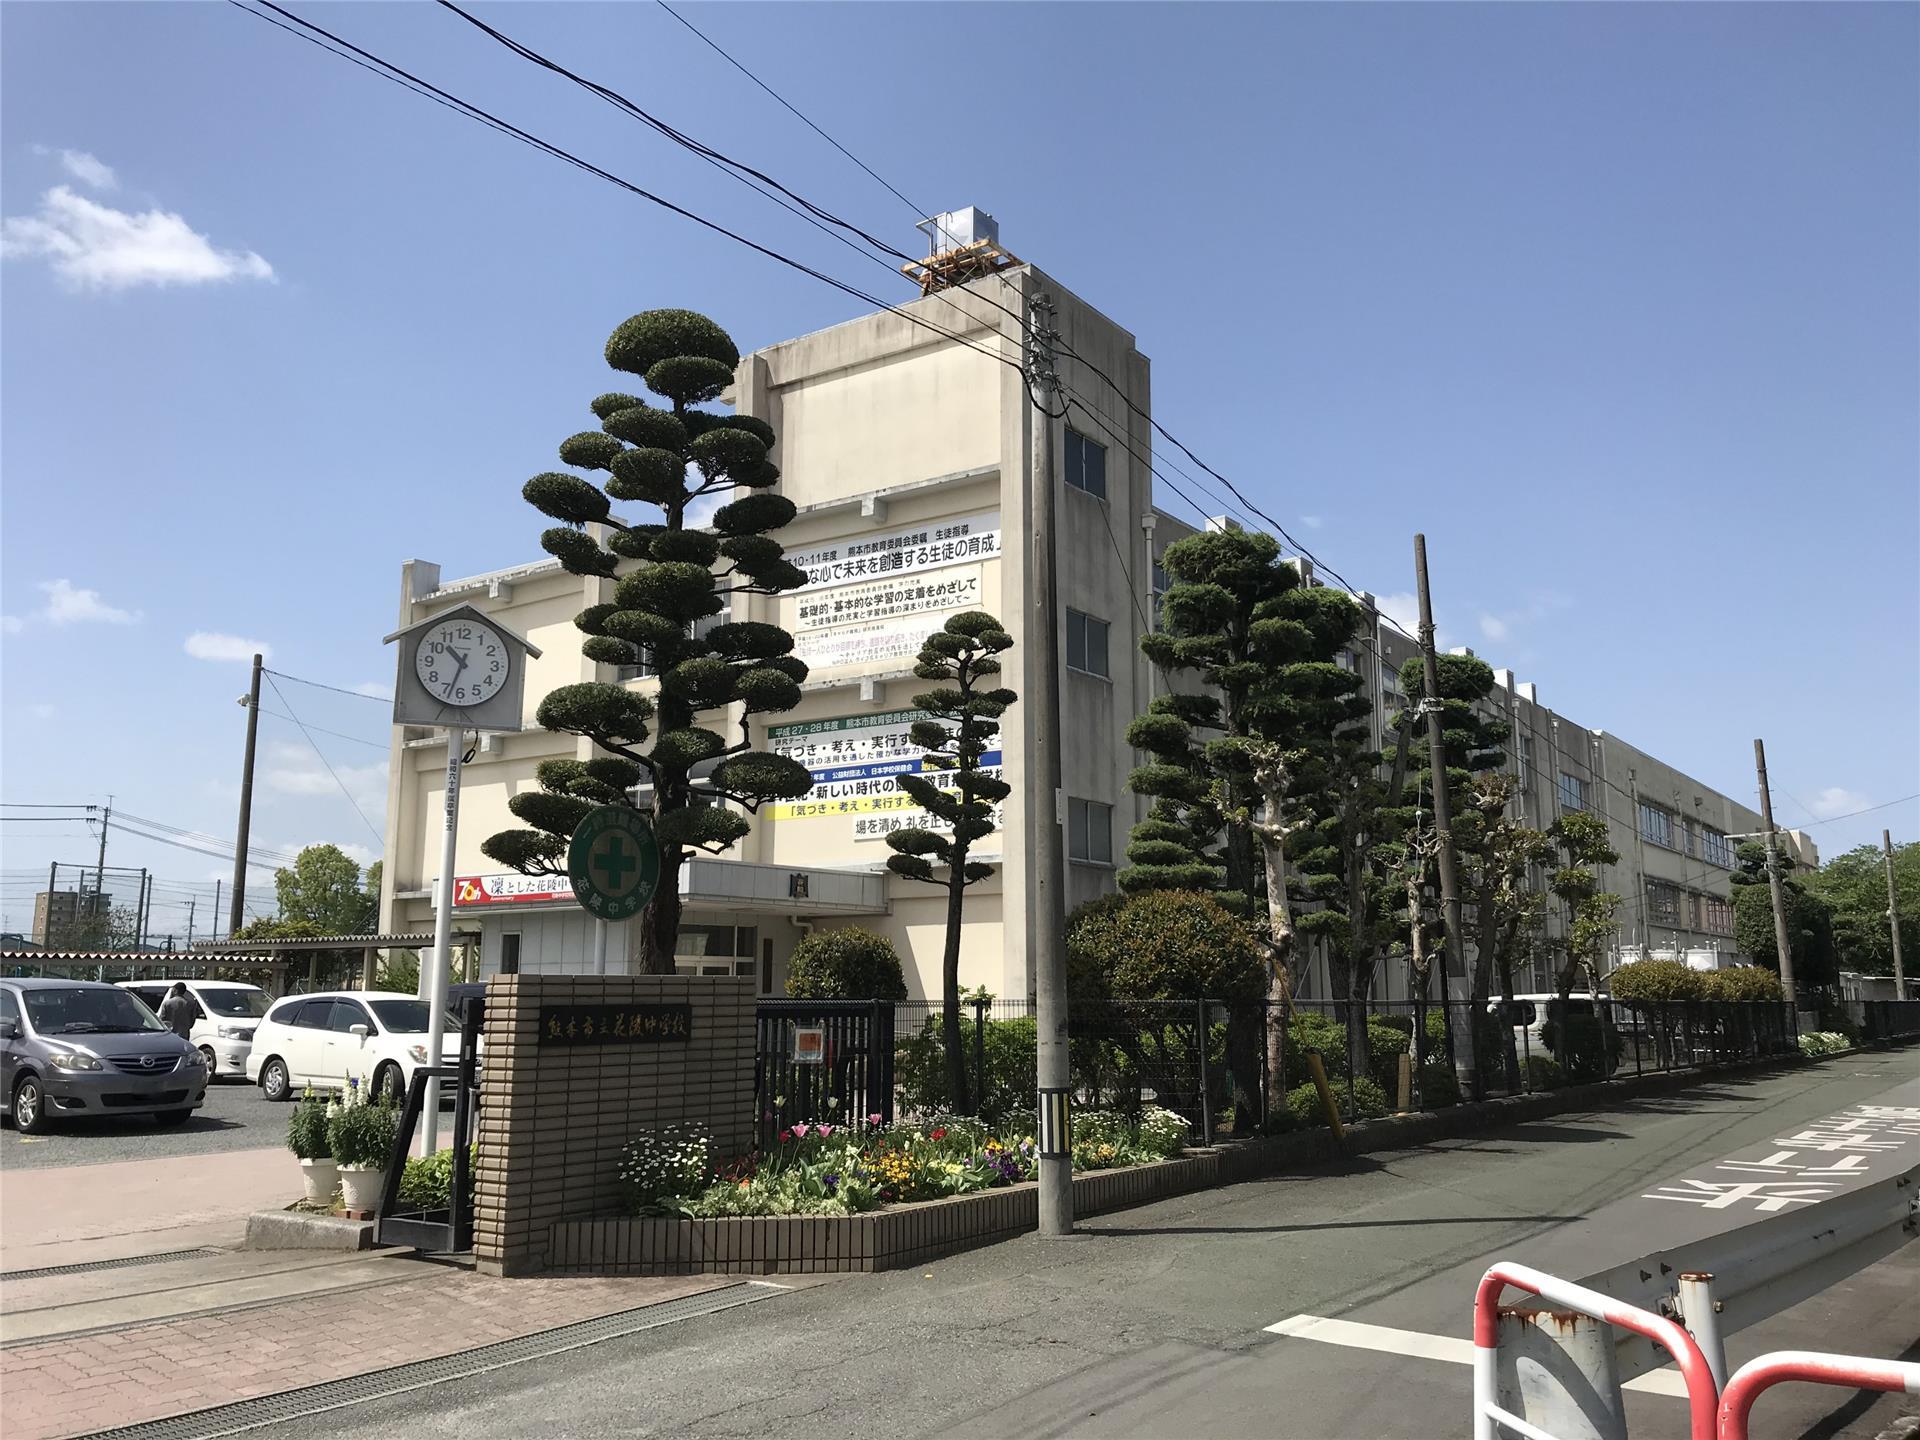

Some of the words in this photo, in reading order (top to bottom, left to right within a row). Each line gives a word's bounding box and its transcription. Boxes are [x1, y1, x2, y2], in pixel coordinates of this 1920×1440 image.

[935, 524, 969, 541] 生徒指導
[441, 632, 453, 643] 11
[456, 628, 471, 640] 12
[477, 634, 484, 646] 1
[429, 642, 444, 654] 10
[486, 645, 495, 656] 2
[425, 656, 434, 667] 9
[490, 661, 499, 672] 3
[429, 671, 438, 682] 8
[483, 675, 493, 686] 4
[441, 682, 451, 694] 7
[456, 688, 465, 699] 6
[472, 685, 481, 696] 5
[775, 735, 808, 746] 研究テーマ
[832, 768, 867, 779] 公益財団法人
[871, 762, 913, 775] 日本学校保健会
[855, 817, 902, 835] 場を清め
